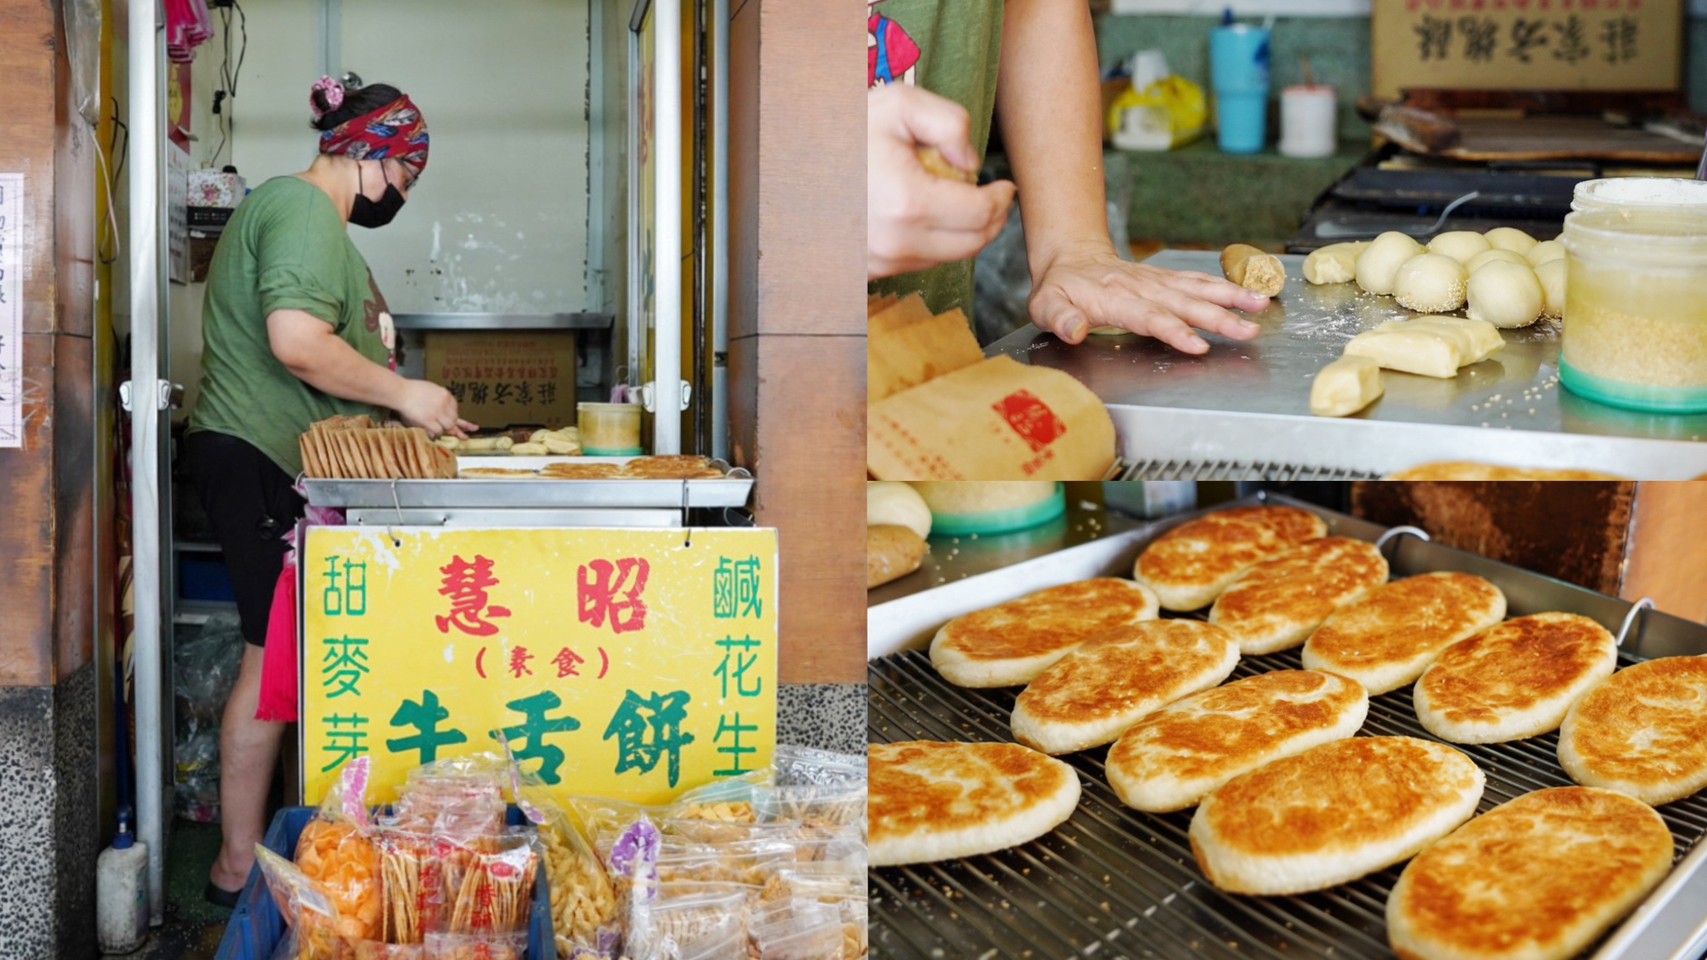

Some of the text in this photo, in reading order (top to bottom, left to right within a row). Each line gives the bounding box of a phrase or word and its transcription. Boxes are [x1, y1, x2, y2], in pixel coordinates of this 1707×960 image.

[321, 555, 370, 774] 甜麥芽
[385, 687, 696, 789] 牛舌餅
[712, 554, 764, 778] 鹹花生
